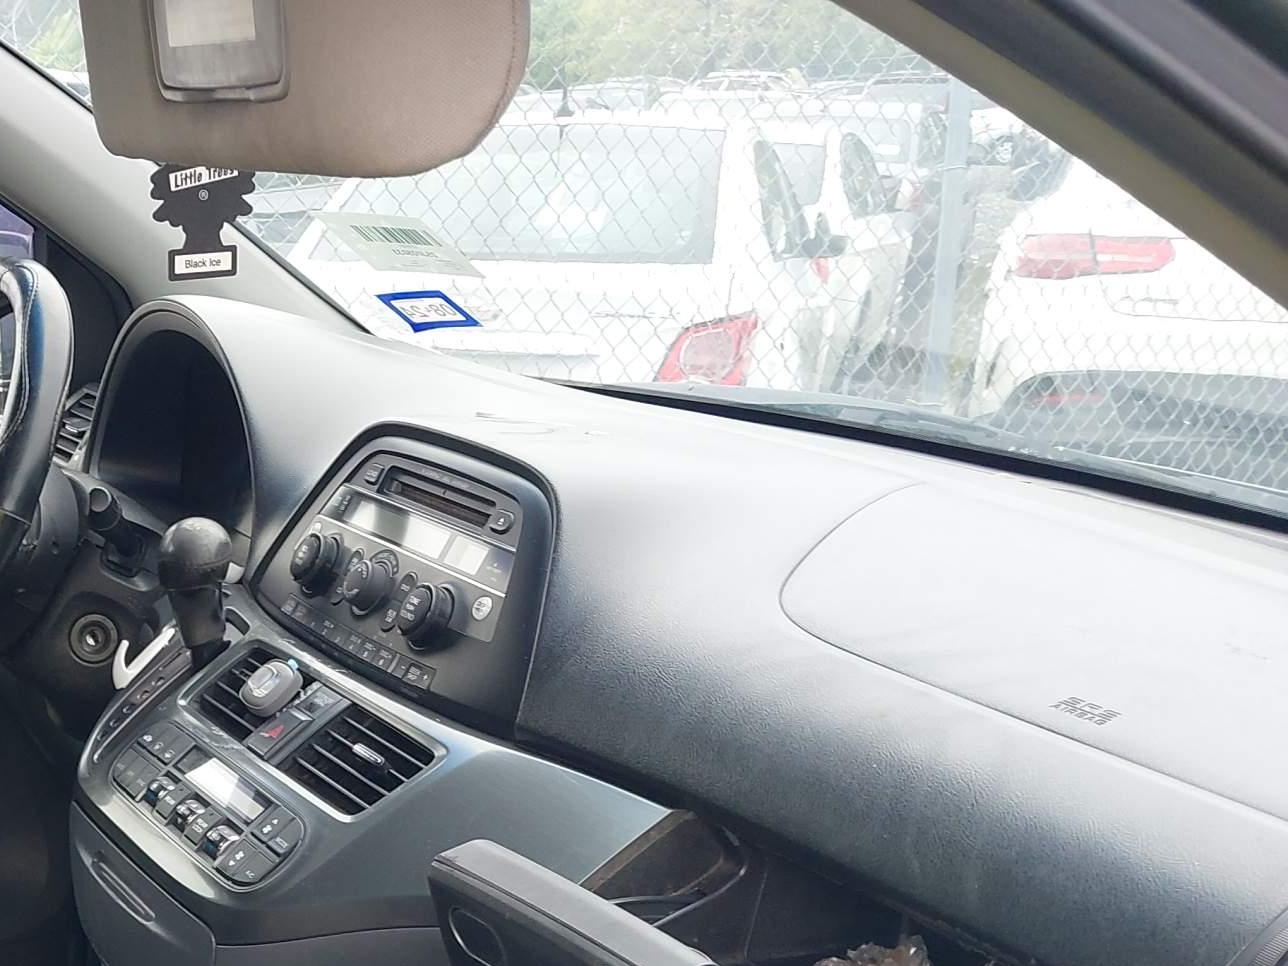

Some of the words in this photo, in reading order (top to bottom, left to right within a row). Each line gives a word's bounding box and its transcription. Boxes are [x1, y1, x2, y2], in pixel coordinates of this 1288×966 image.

[174, 169, 204, 189] Little
[185, 258, 208, 269] Black
[209, 257, 222, 267] Ice
[1048, 703, 1108, 726] AIRBAG
